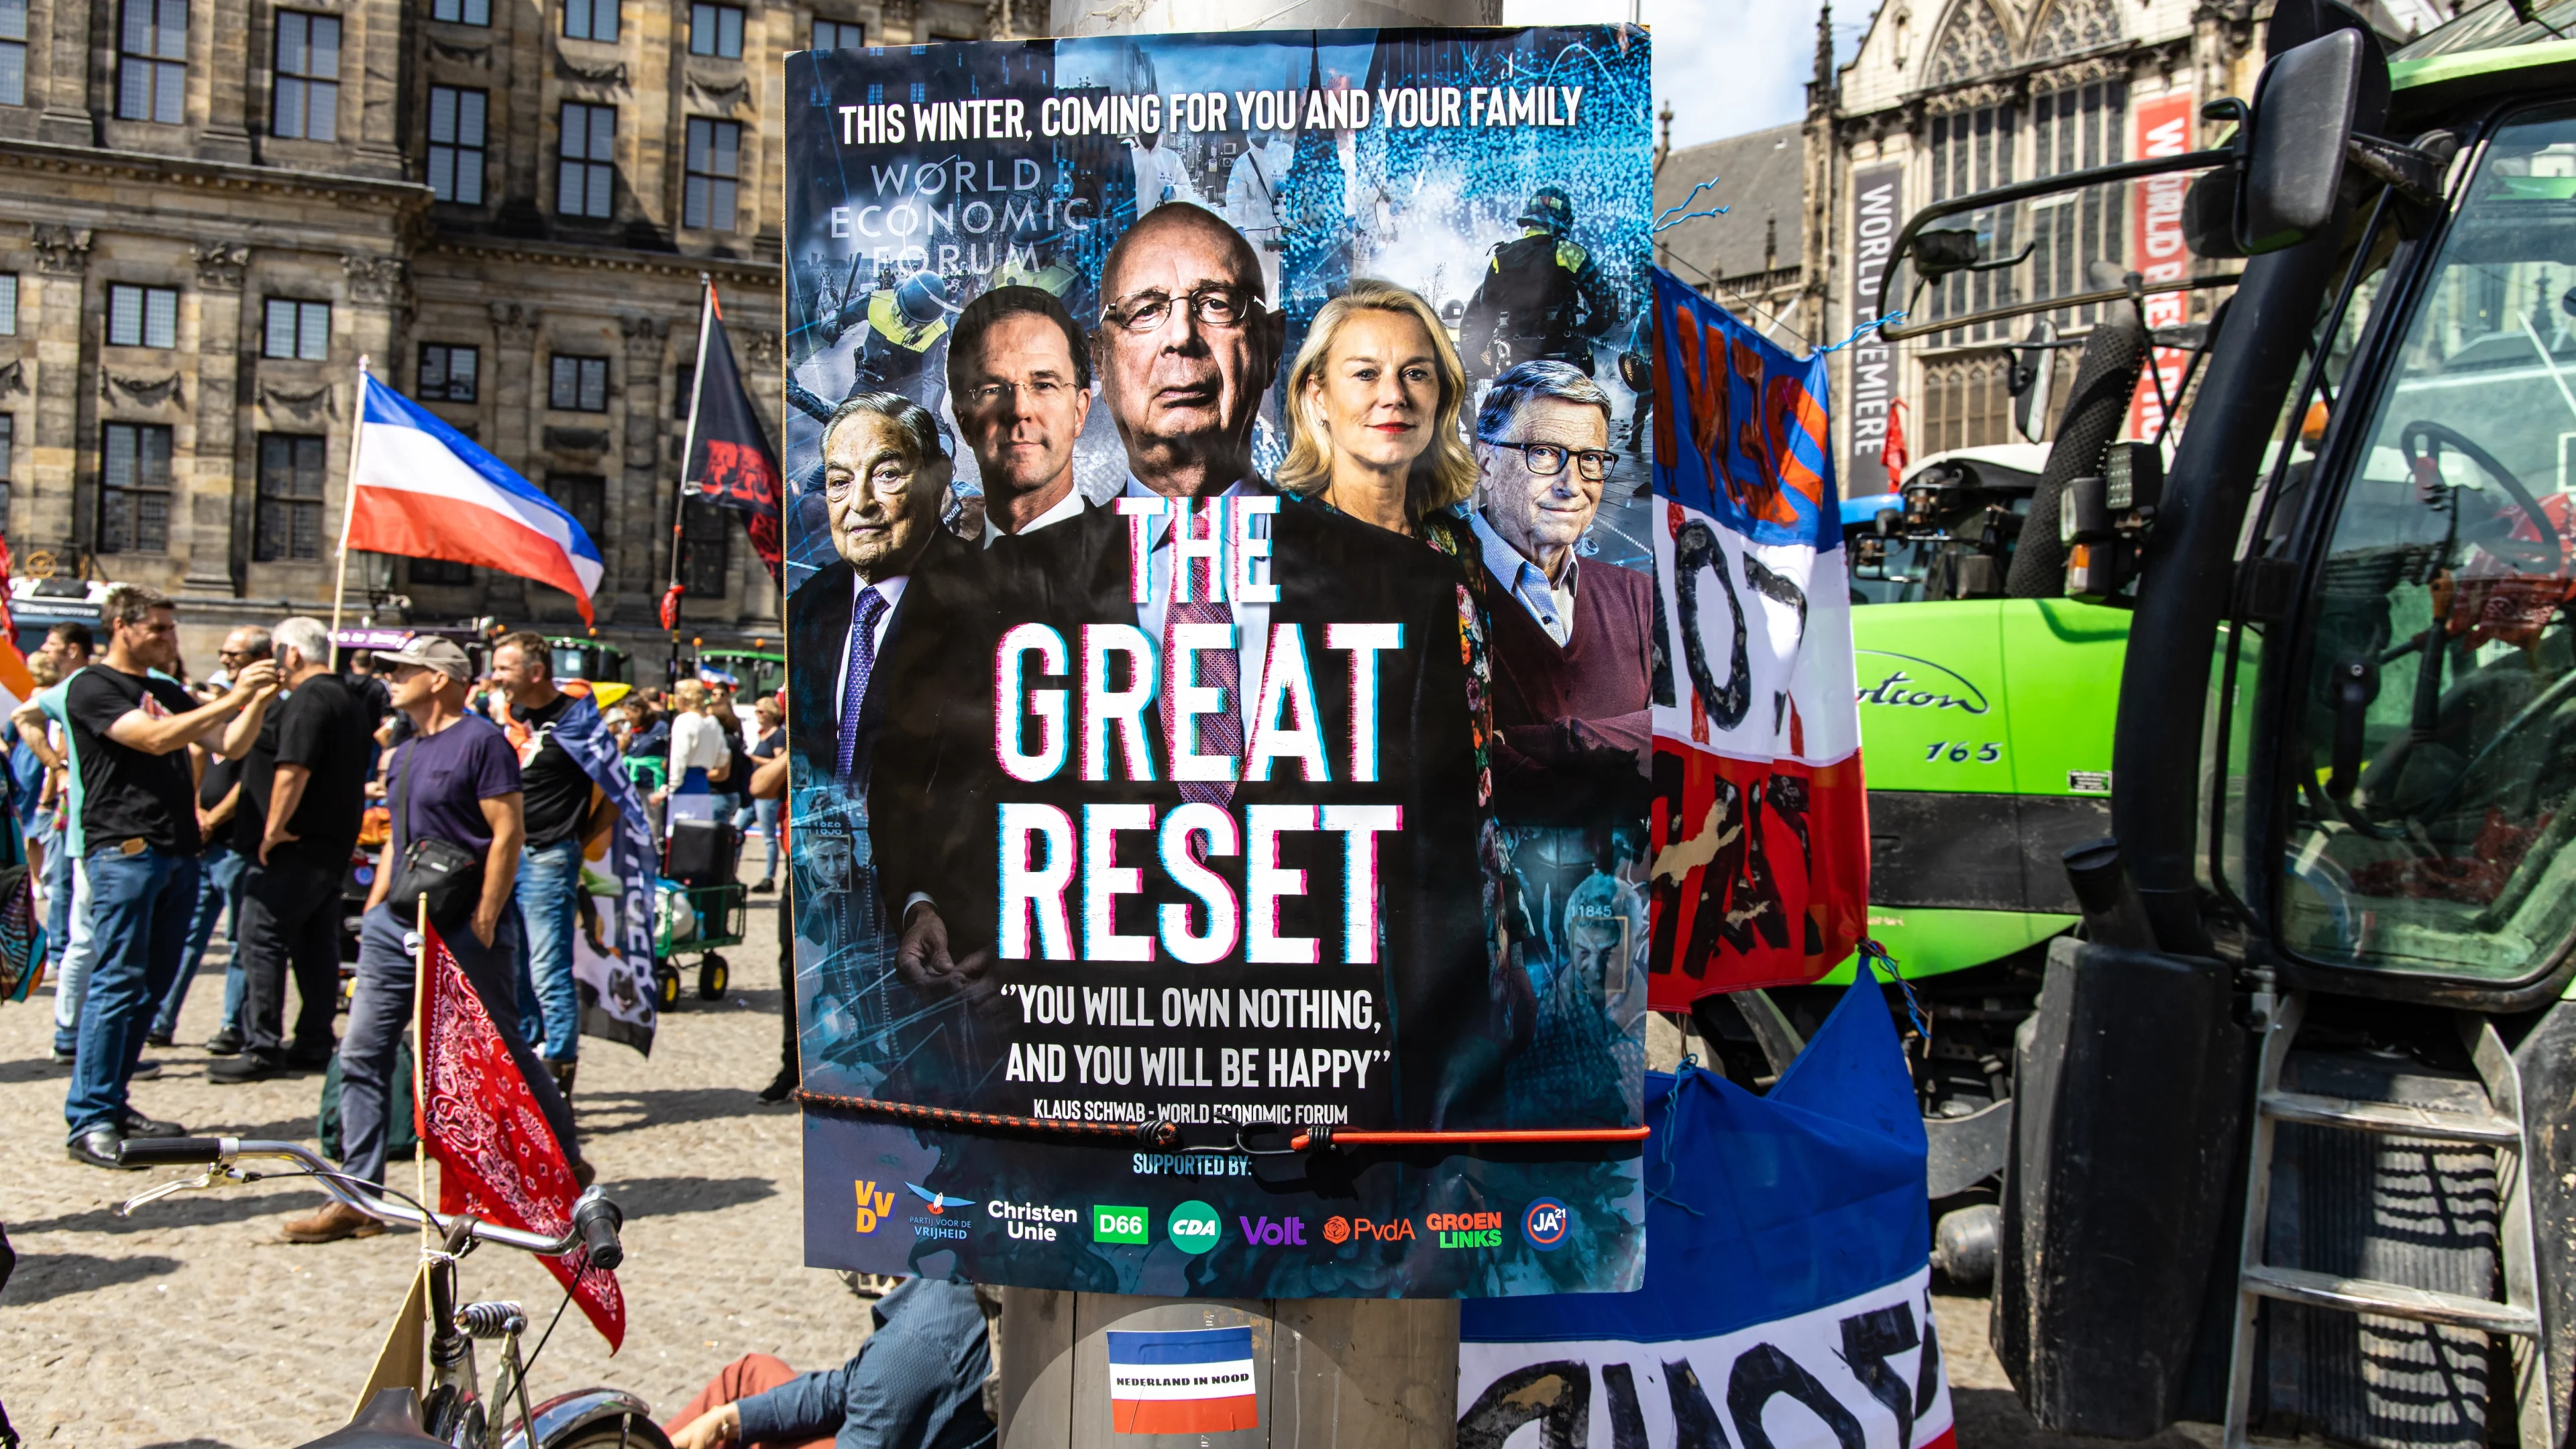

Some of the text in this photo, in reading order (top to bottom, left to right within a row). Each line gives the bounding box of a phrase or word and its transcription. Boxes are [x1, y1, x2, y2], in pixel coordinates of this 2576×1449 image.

[839, 86, 1583, 144] THIS WINTER, COMING FOR YOU AND YOUR FAMILY
[871, 158, 1040, 197] WORLD
[831, 197, 1089, 238] ECONOMIC
[1858, 182, 1893, 296] WORLD
[873, 242, 1040, 278] FORUM
[1115, 496, 1281, 603] THE
[994, 623, 1405, 782] GREAT
[1925, 741, 2003, 764] 165
[996, 802, 1403, 964] RESET
[1570, 905, 1612, 917] 11845
[1083, 987, 1154, 1026] WILL
[1162, 988, 1230, 1028] OWN
[1239, 988, 1381, 1034] NOTHING,
[1006, 1043, 1066, 1083] AND
[1073, 1044, 1131, 1085] YOU
[1140, 1046, 1213, 1087] WILL
[1221, 1048, 1258, 1087] BE
[1034, 1099, 1081, 1120] KLAUS
[1084, 1101, 1145, 1122] SCHWAB
[1157, 1103, 1210, 1124] WORLD
[1213, 1104, 1291, 1124] ECONOMIC
[1295, 1104, 1348, 1124] FORUM
[1133, 1152, 1252, 1176] SUPPORTED BY:
[910, 1216, 971, 1228] PARTIJ VOOR DE
[987, 1200, 1077, 1224] Christen
[1426, 1212, 1503, 1232] GROEN
[914, 1226, 967, 1240] VRIJHEID
[1007, 1221, 1057, 1242] Unie
[1099, 1214, 1142, 1235] D66
[1173, 1218, 1216, 1237] CDA
[1239, 1216, 1307, 1246] Volt
[1354, 1218, 1416, 1241] PvdA
[1439, 1229, 1503, 1249] LINKS
[1116, 1373, 1249, 1387] NEDERLAND IN NOOD
